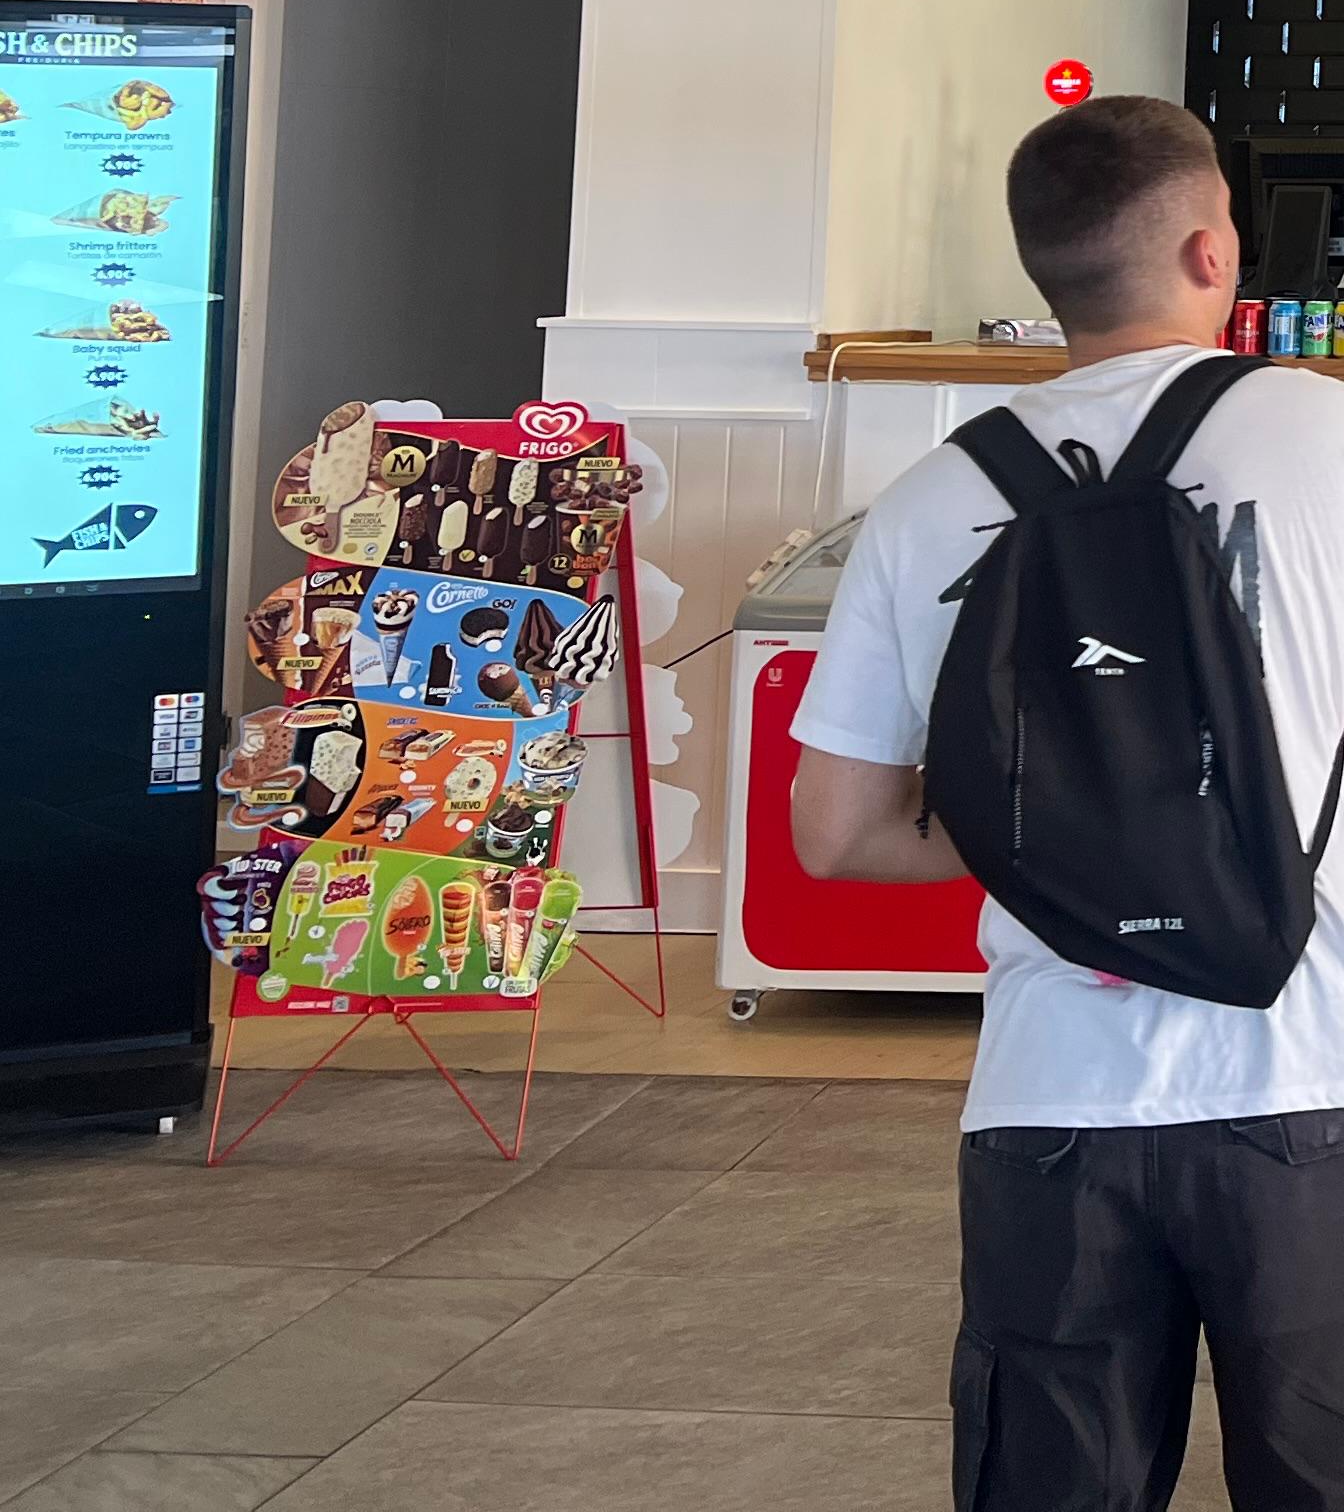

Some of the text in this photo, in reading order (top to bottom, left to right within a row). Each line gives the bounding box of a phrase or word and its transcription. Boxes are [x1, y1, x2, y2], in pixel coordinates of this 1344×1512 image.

[31, 32, 49, 54] &
[54, 33, 138, 58] CHIPS
[65, 130, 171, 144] Tempura prawns
[69, 240, 158, 253] Shrimp fritters
[72, 344, 142, 355] Baby squid
[53, 444, 151, 456] Fried anchovies
[518, 441, 573, 456] FRIGO
[584, 459, 614, 469] NUEVO
[291, 496, 321, 506] NUEVO
[553, 556, 568, 569] 12
[306, 570, 365, 596] MAX
[426, 581, 490, 614] Cornetto
[285, 659, 315, 669] NUEVO
[257, 792, 288, 802] NUEVO
[450, 801, 481, 811] NUEVO
[222, 856, 283, 874] TWSTER
[1118, 917, 1161, 934] SIERRA
[232, 936, 263, 945] NUEVO
